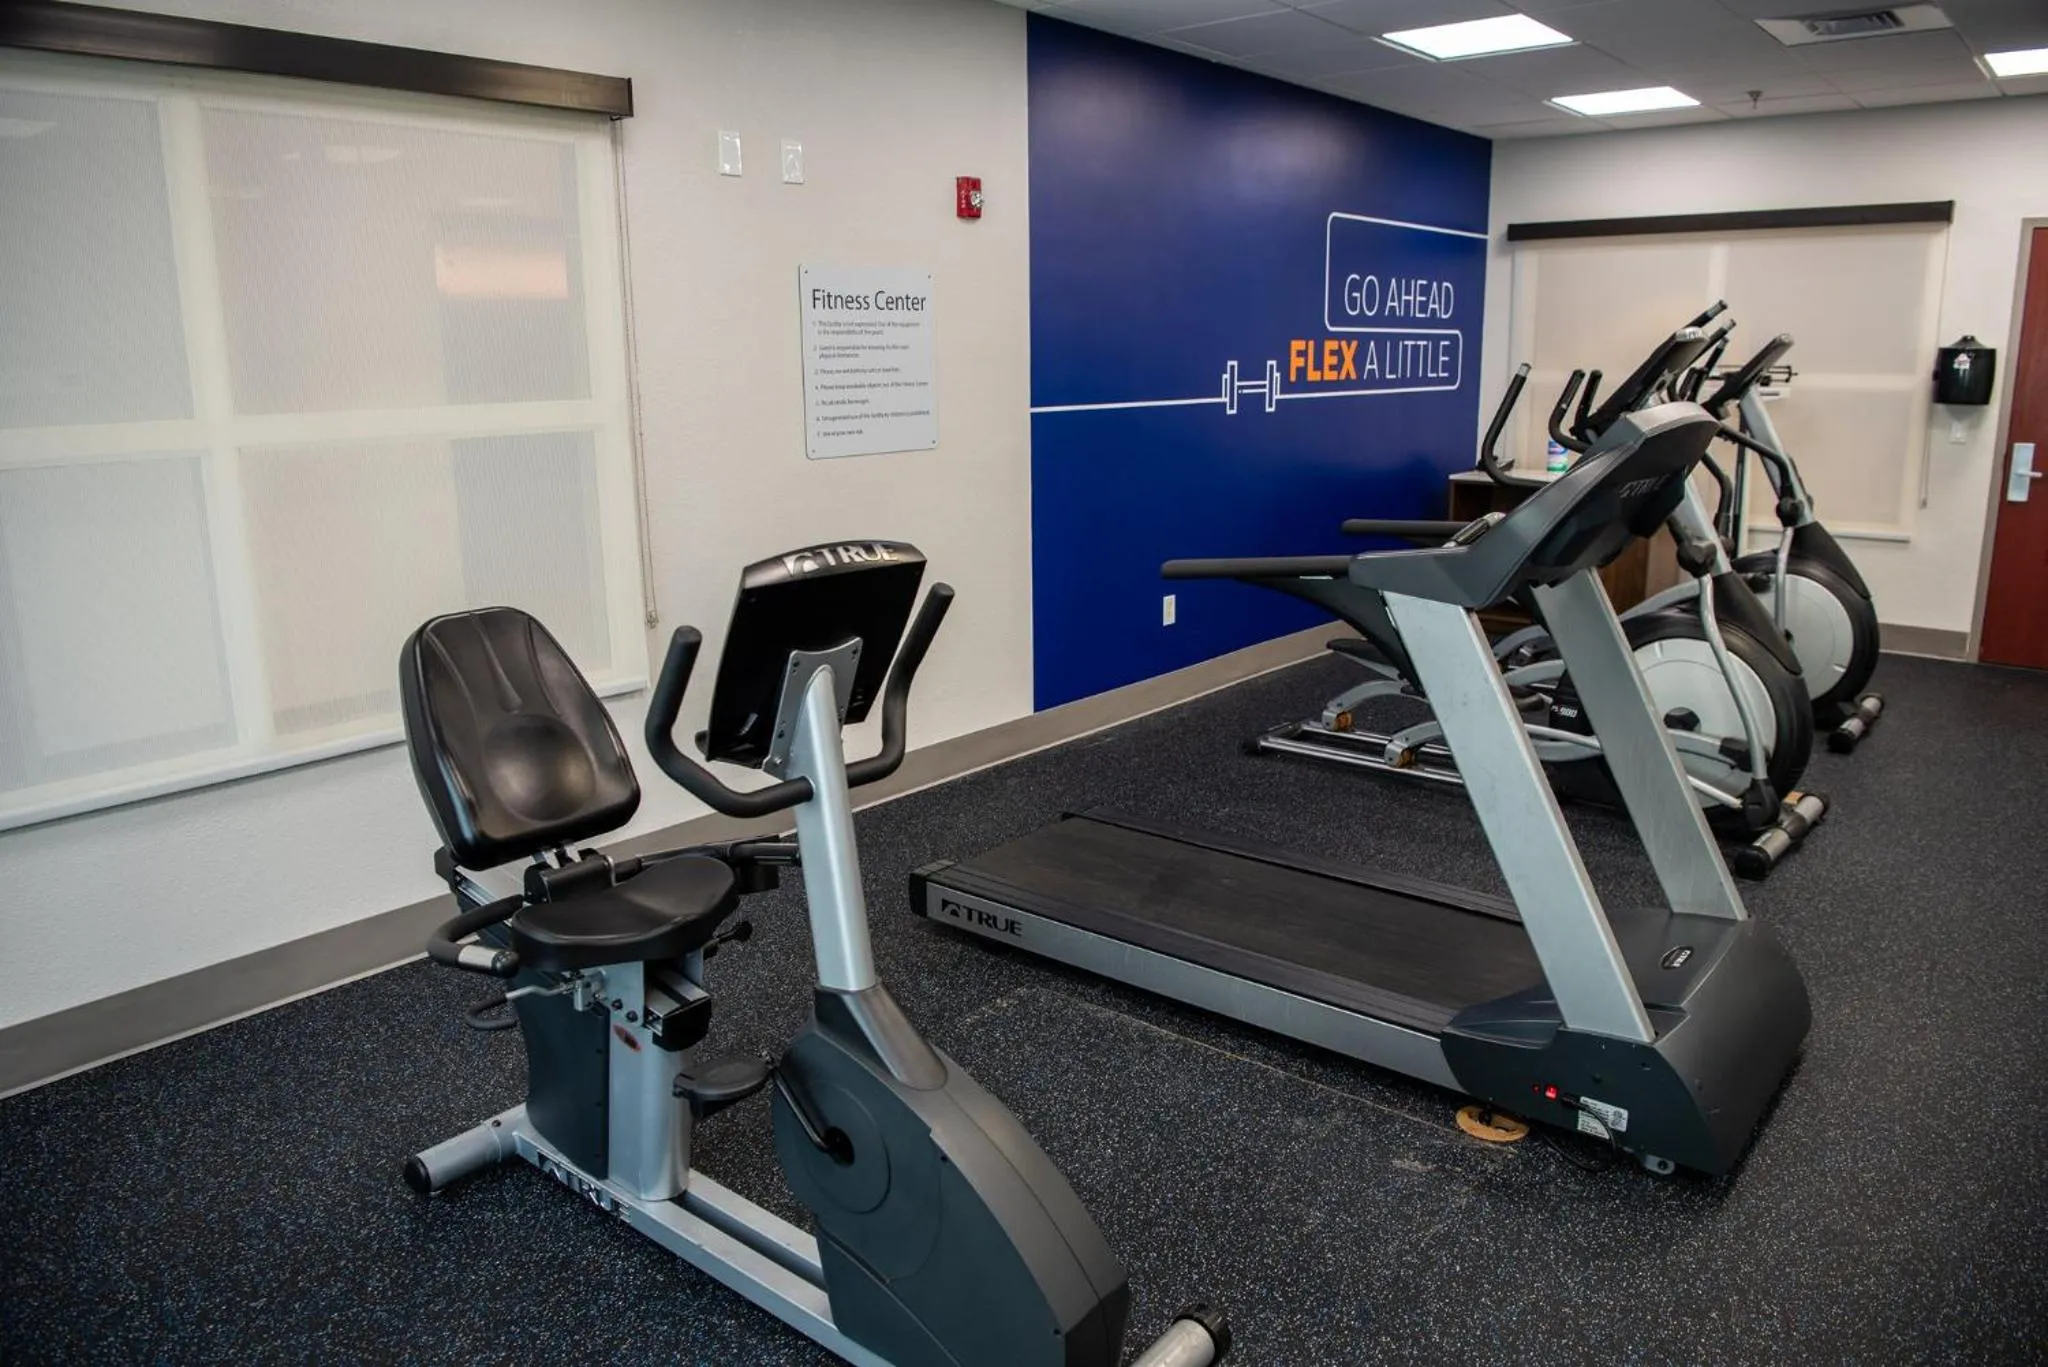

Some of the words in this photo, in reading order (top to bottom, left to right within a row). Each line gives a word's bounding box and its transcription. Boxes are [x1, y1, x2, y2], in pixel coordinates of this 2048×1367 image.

[812, 288, 870, 310] Fitness
[874, 290, 926, 311] Center
[1344, 274, 1380, 316] GO
[1385, 277, 1454, 319] AHEAD
[1289, 339, 1358, 382] FLEX
[1363, 340, 1379, 380] A
[1385, 340, 1451, 380] LITTLE
[815, 543, 898, 566] TRUE
[962, 906, 1023, 937] TRUE
